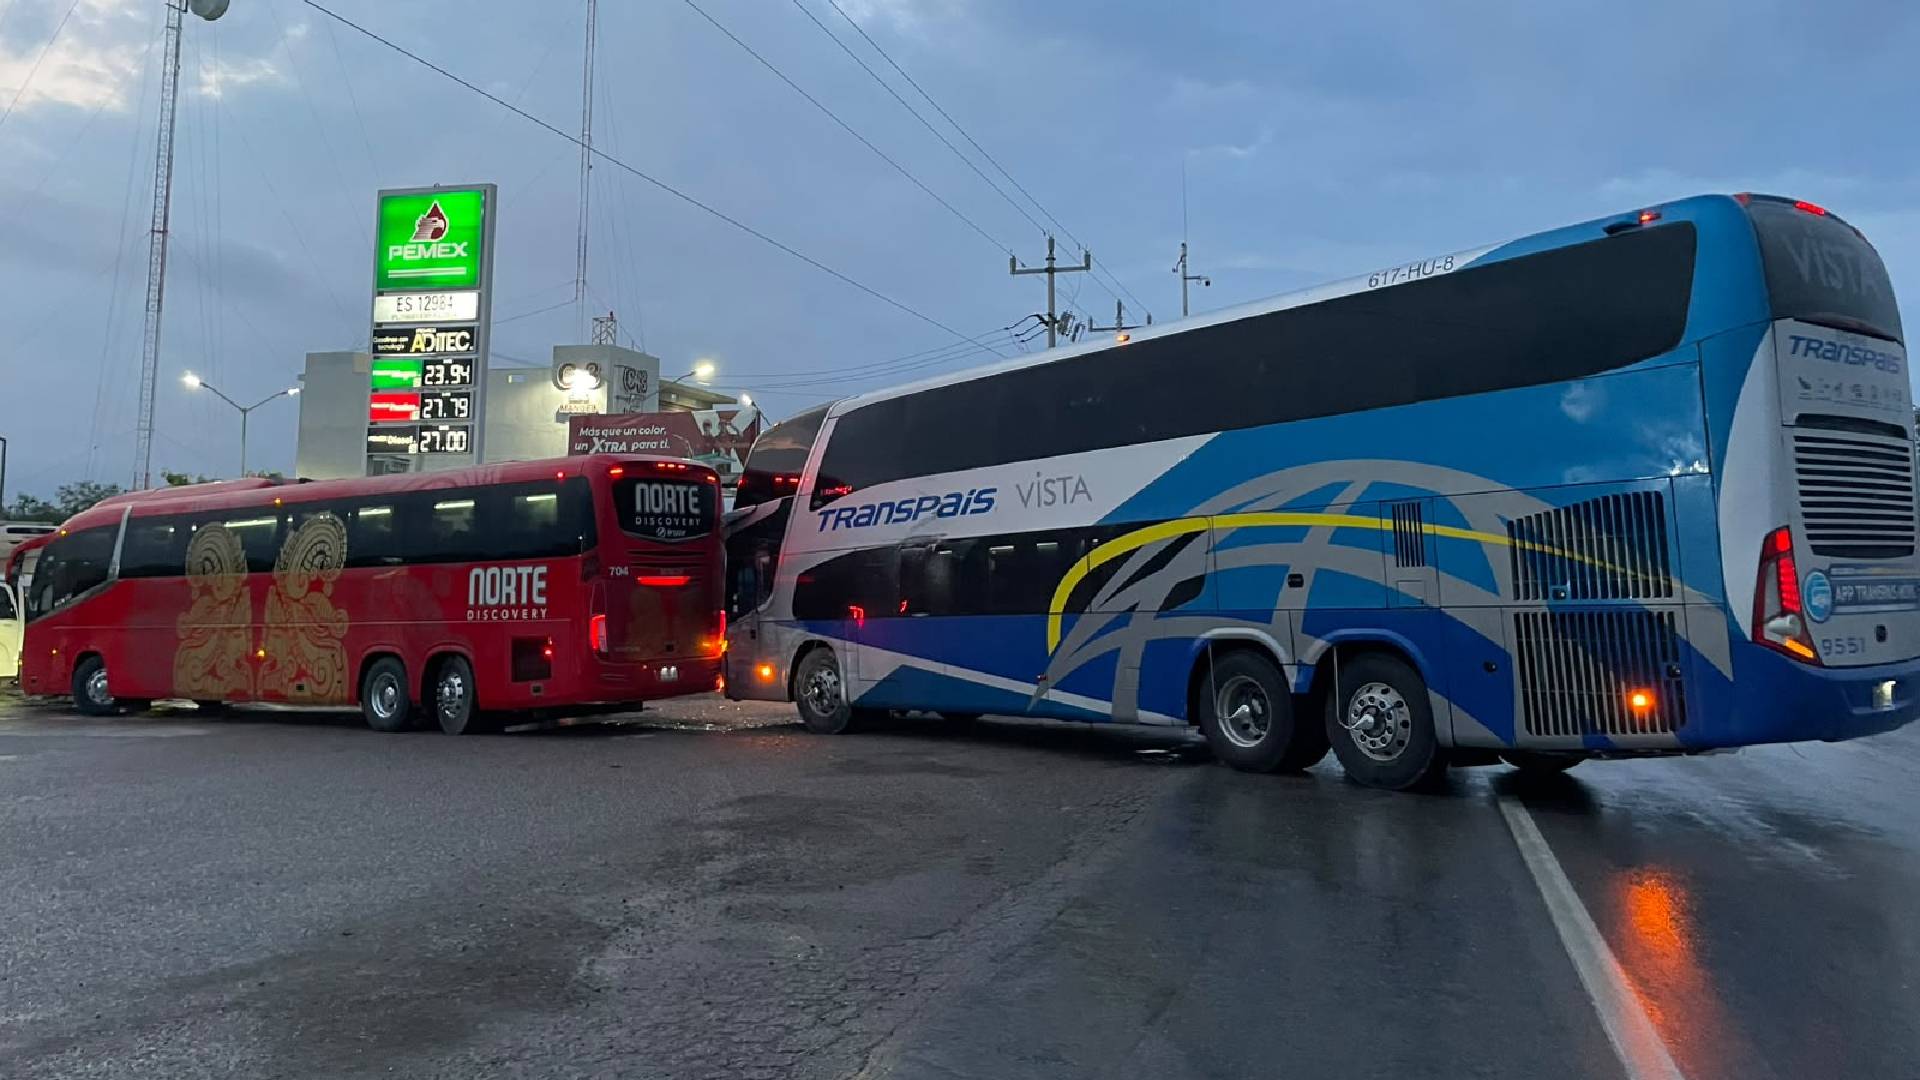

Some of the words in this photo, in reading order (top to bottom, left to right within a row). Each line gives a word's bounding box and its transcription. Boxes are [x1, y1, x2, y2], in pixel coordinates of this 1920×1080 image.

[388, 242, 468, 261] PEMEX
[1367, 255, 1454, 288] 617-HU-8
[396, 297, 413, 312] ES
[424, 364, 471, 385] 23.94
[422, 398, 469, 418] 27.79
[420, 431, 467, 453] 27.00
[601, 428, 621, 438] que
[623, 428, 637, 436] un
[574, 442, 589, 451] un
[589, 437, 627, 454] XTRA
[631, 441, 657, 452] para
[635, 483, 700, 514] NORTE
[635, 517, 701, 526] DISCOVERY
[609, 566, 629, 577] 704
[468, 566, 548, 605] NORTE
[467, 608, 548, 621] DISCOVERY
[1822, 638, 1866, 656] 9551
